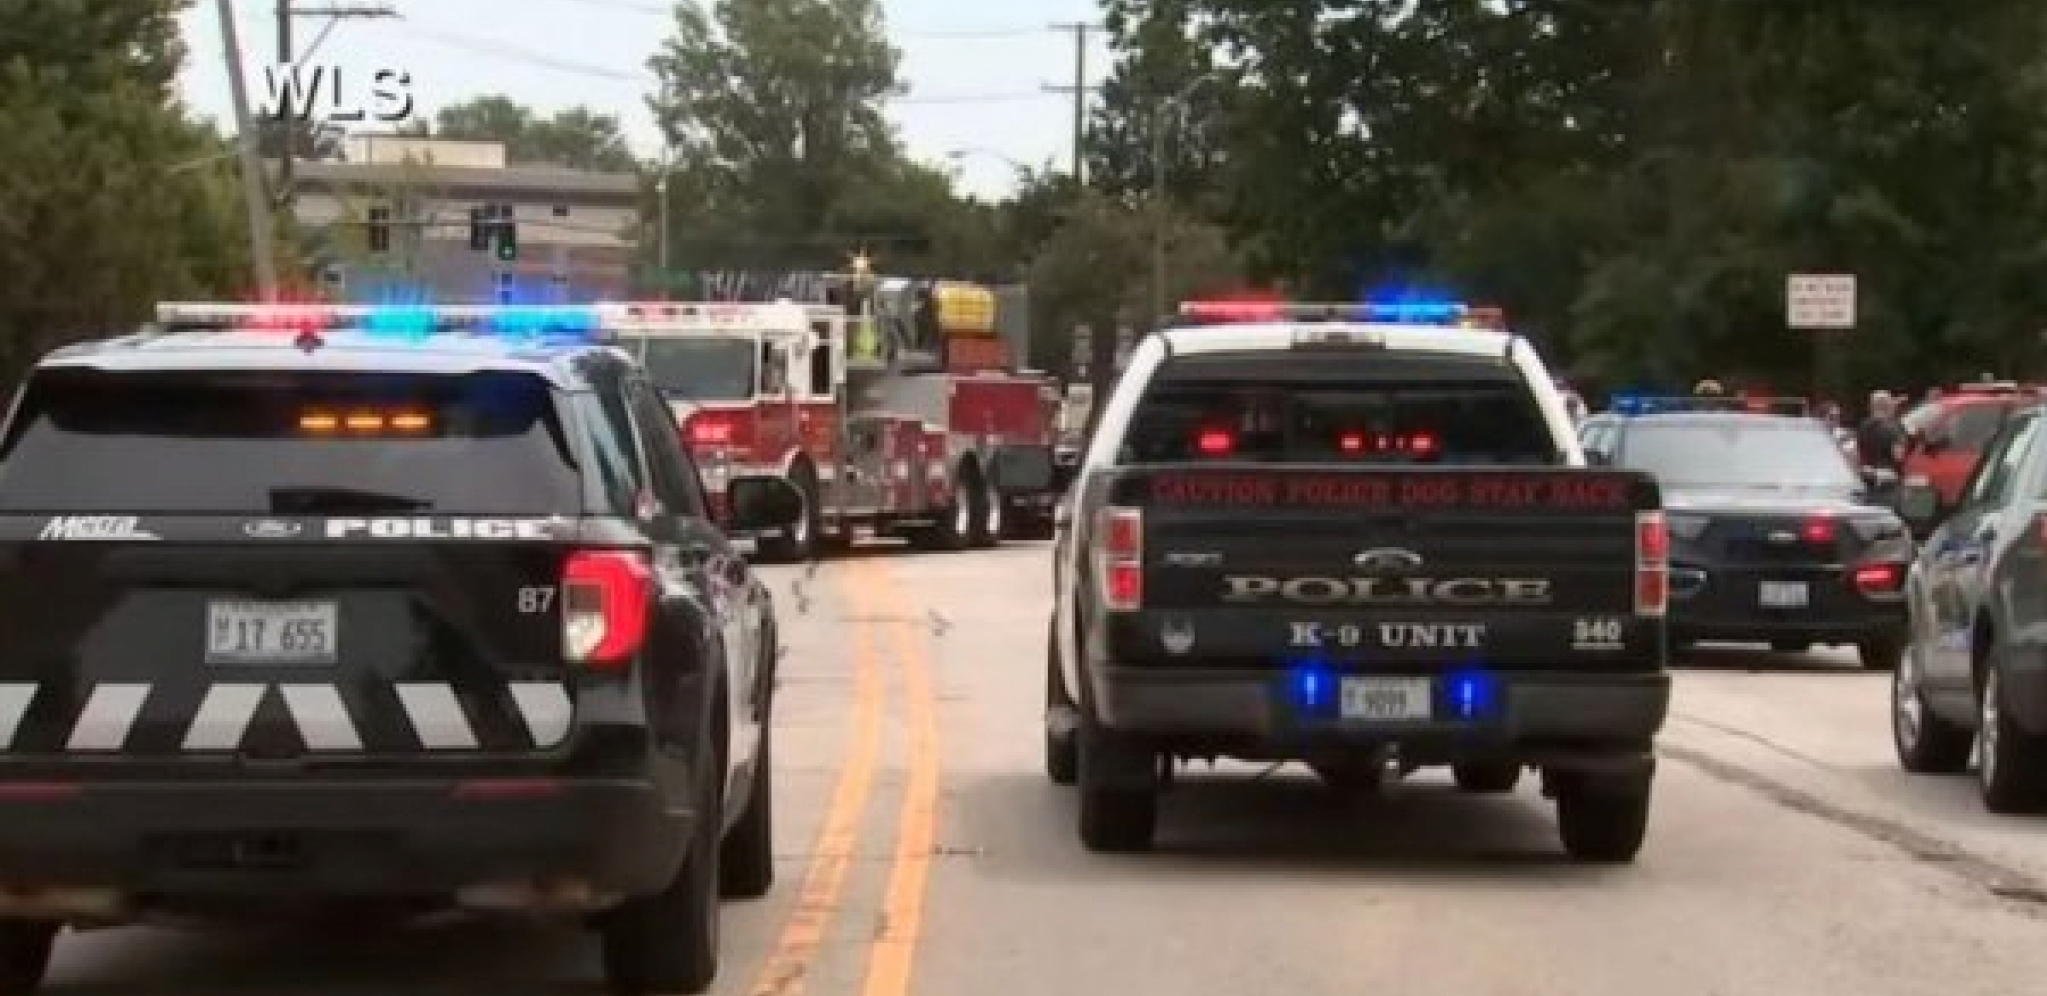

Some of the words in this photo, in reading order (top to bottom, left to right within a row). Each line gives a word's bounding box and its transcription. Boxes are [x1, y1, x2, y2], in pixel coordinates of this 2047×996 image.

[1151, 479, 1274, 505] CAUTION
[1286, 479, 1391, 505] POLICE
[1401, 479, 1456, 505] DOG
[1470, 479, 1539, 505] STAY
[1550, 479, 1630, 506] BACK
[324, 516, 555, 540] POLICE
[519, 587, 554, 613] 87
[1223, 577, 1551, 603] POLICE
[237, 618, 266, 651] 17
[281, 618, 326, 651] 655
[1379, 620, 1487, 647] UNIT
